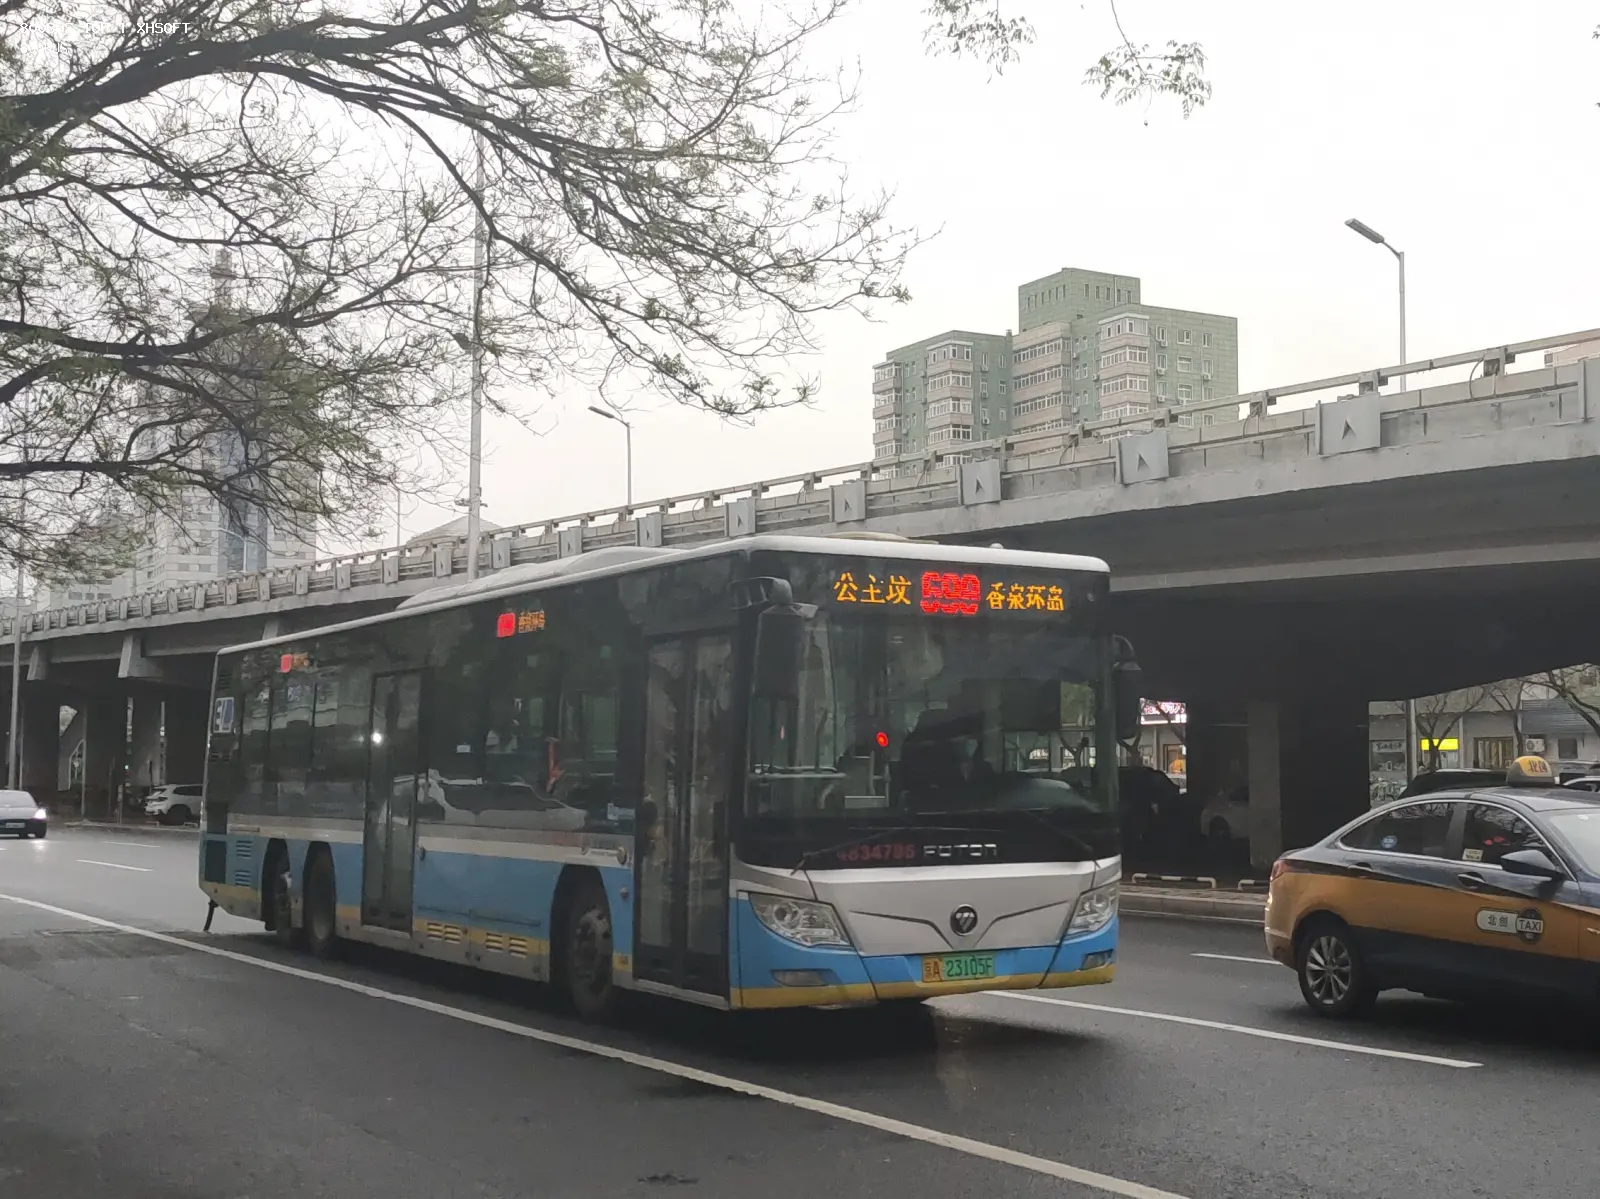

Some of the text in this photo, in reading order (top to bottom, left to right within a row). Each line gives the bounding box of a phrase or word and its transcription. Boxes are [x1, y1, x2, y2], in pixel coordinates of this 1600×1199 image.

[834, 572, 912, 605] 公主坟
[1519, 919, 1541, 932] TAXI
